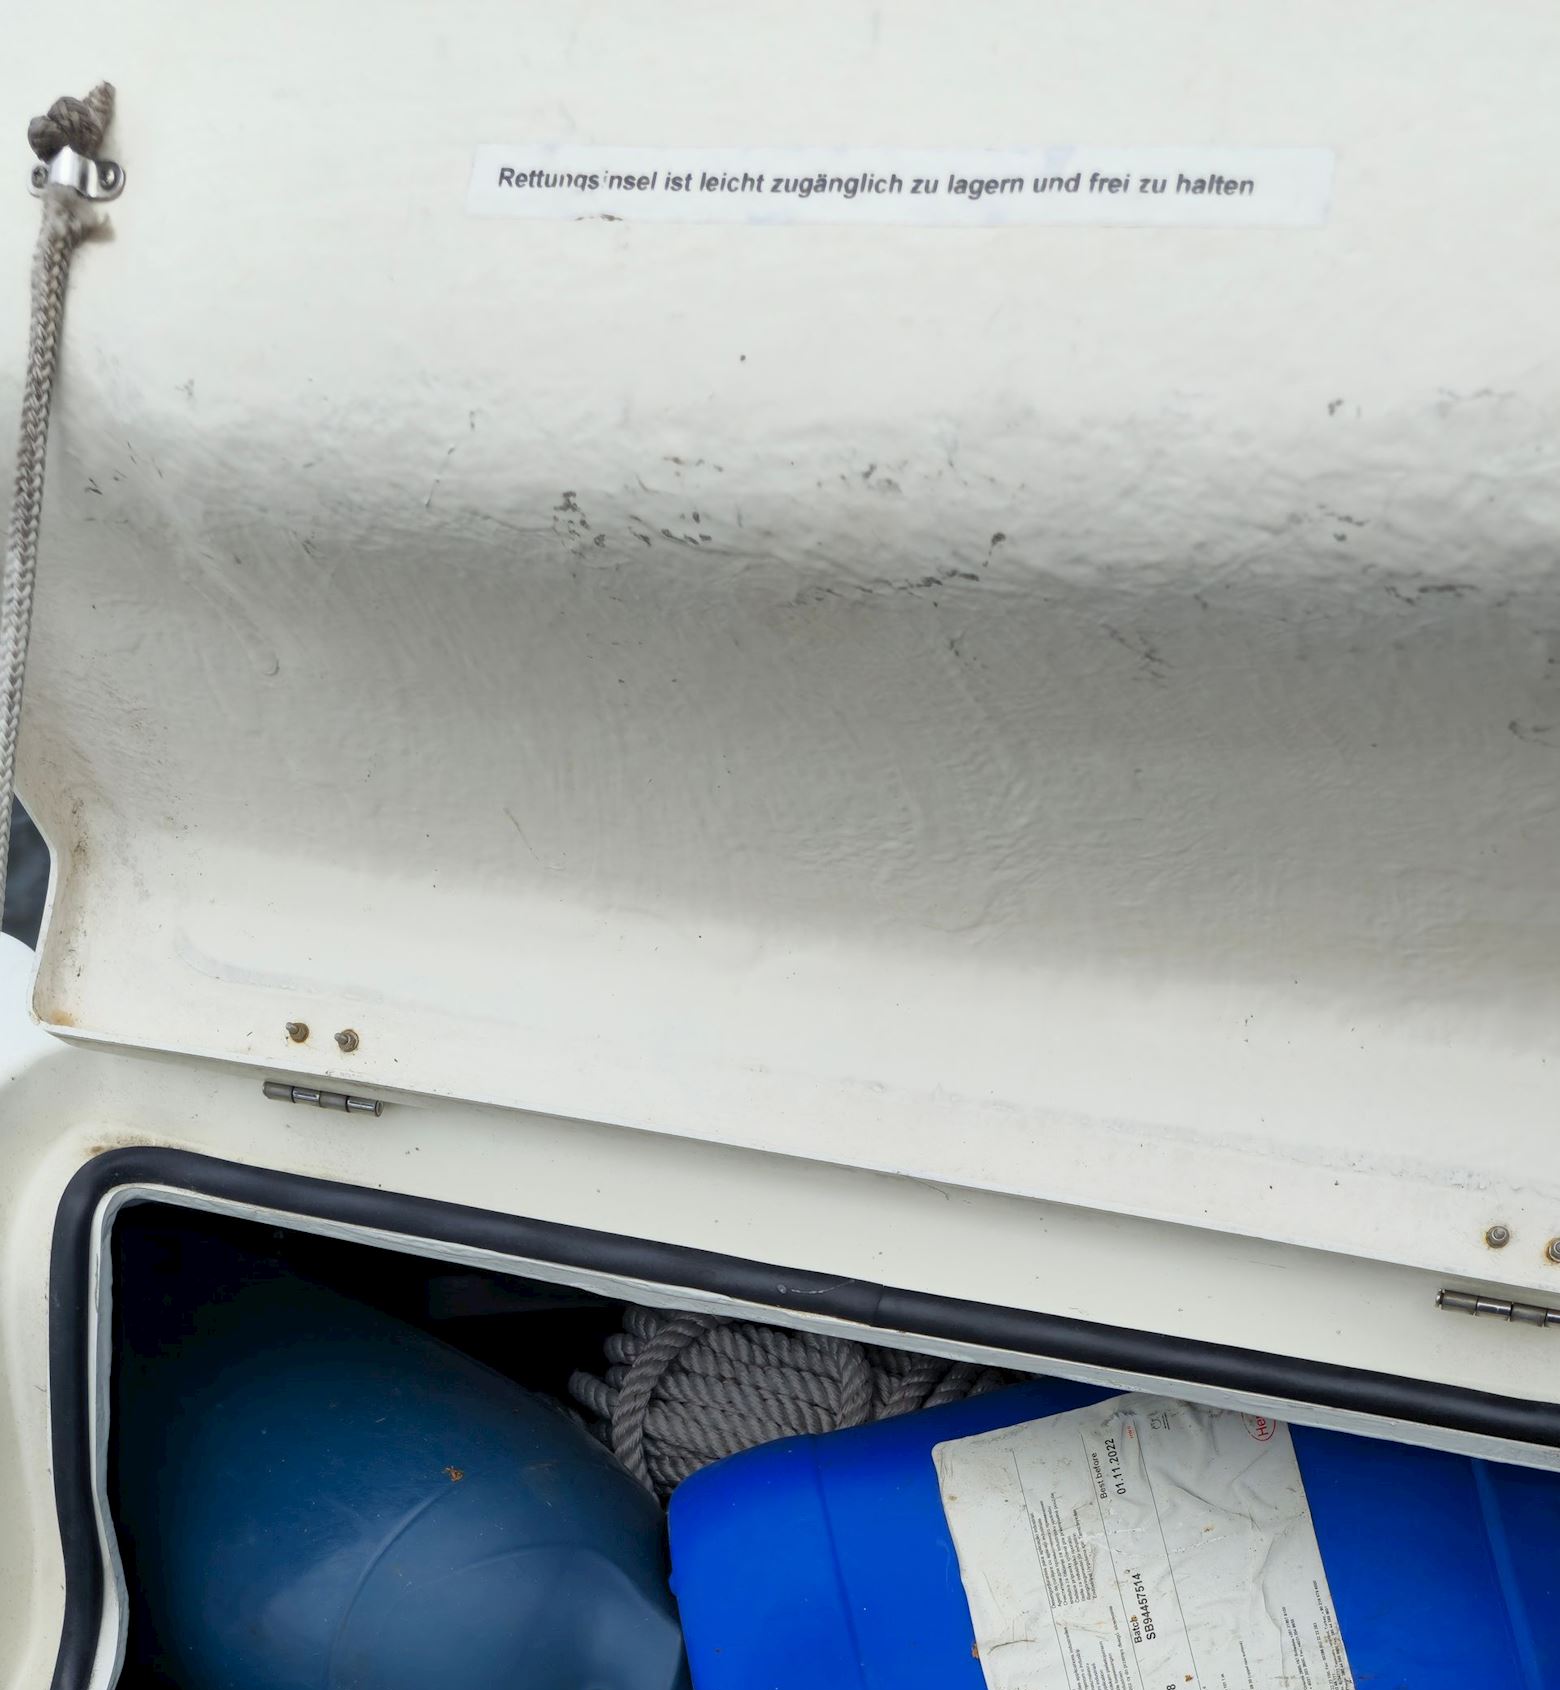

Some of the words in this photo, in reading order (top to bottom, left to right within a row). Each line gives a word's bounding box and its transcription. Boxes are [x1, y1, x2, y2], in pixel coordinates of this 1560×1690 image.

[498, 167, 657, 192] Rettungsinsel
[664, 171, 693, 192] ist
[699, 172, 765, 193] leicht
[770, 173, 903, 199] zugänglich
[910, 178, 939, 194] zu
[947, 174, 1024, 200] lagern
[1033, 173, 1082, 193] und
[1089, 173, 1130, 194] frei
[1139, 178, 1167, 194] zu
[1176, 174, 1255, 196] halten
[1091, 1452, 1102, 1478] before
[1104, 1438, 1126, 1495] 01.11.2022
[1097, 1480, 1108, 1499] Best
[1132, 1573, 1156, 1640] SB94457514
[1130, 1616, 1143, 1643] Batch
